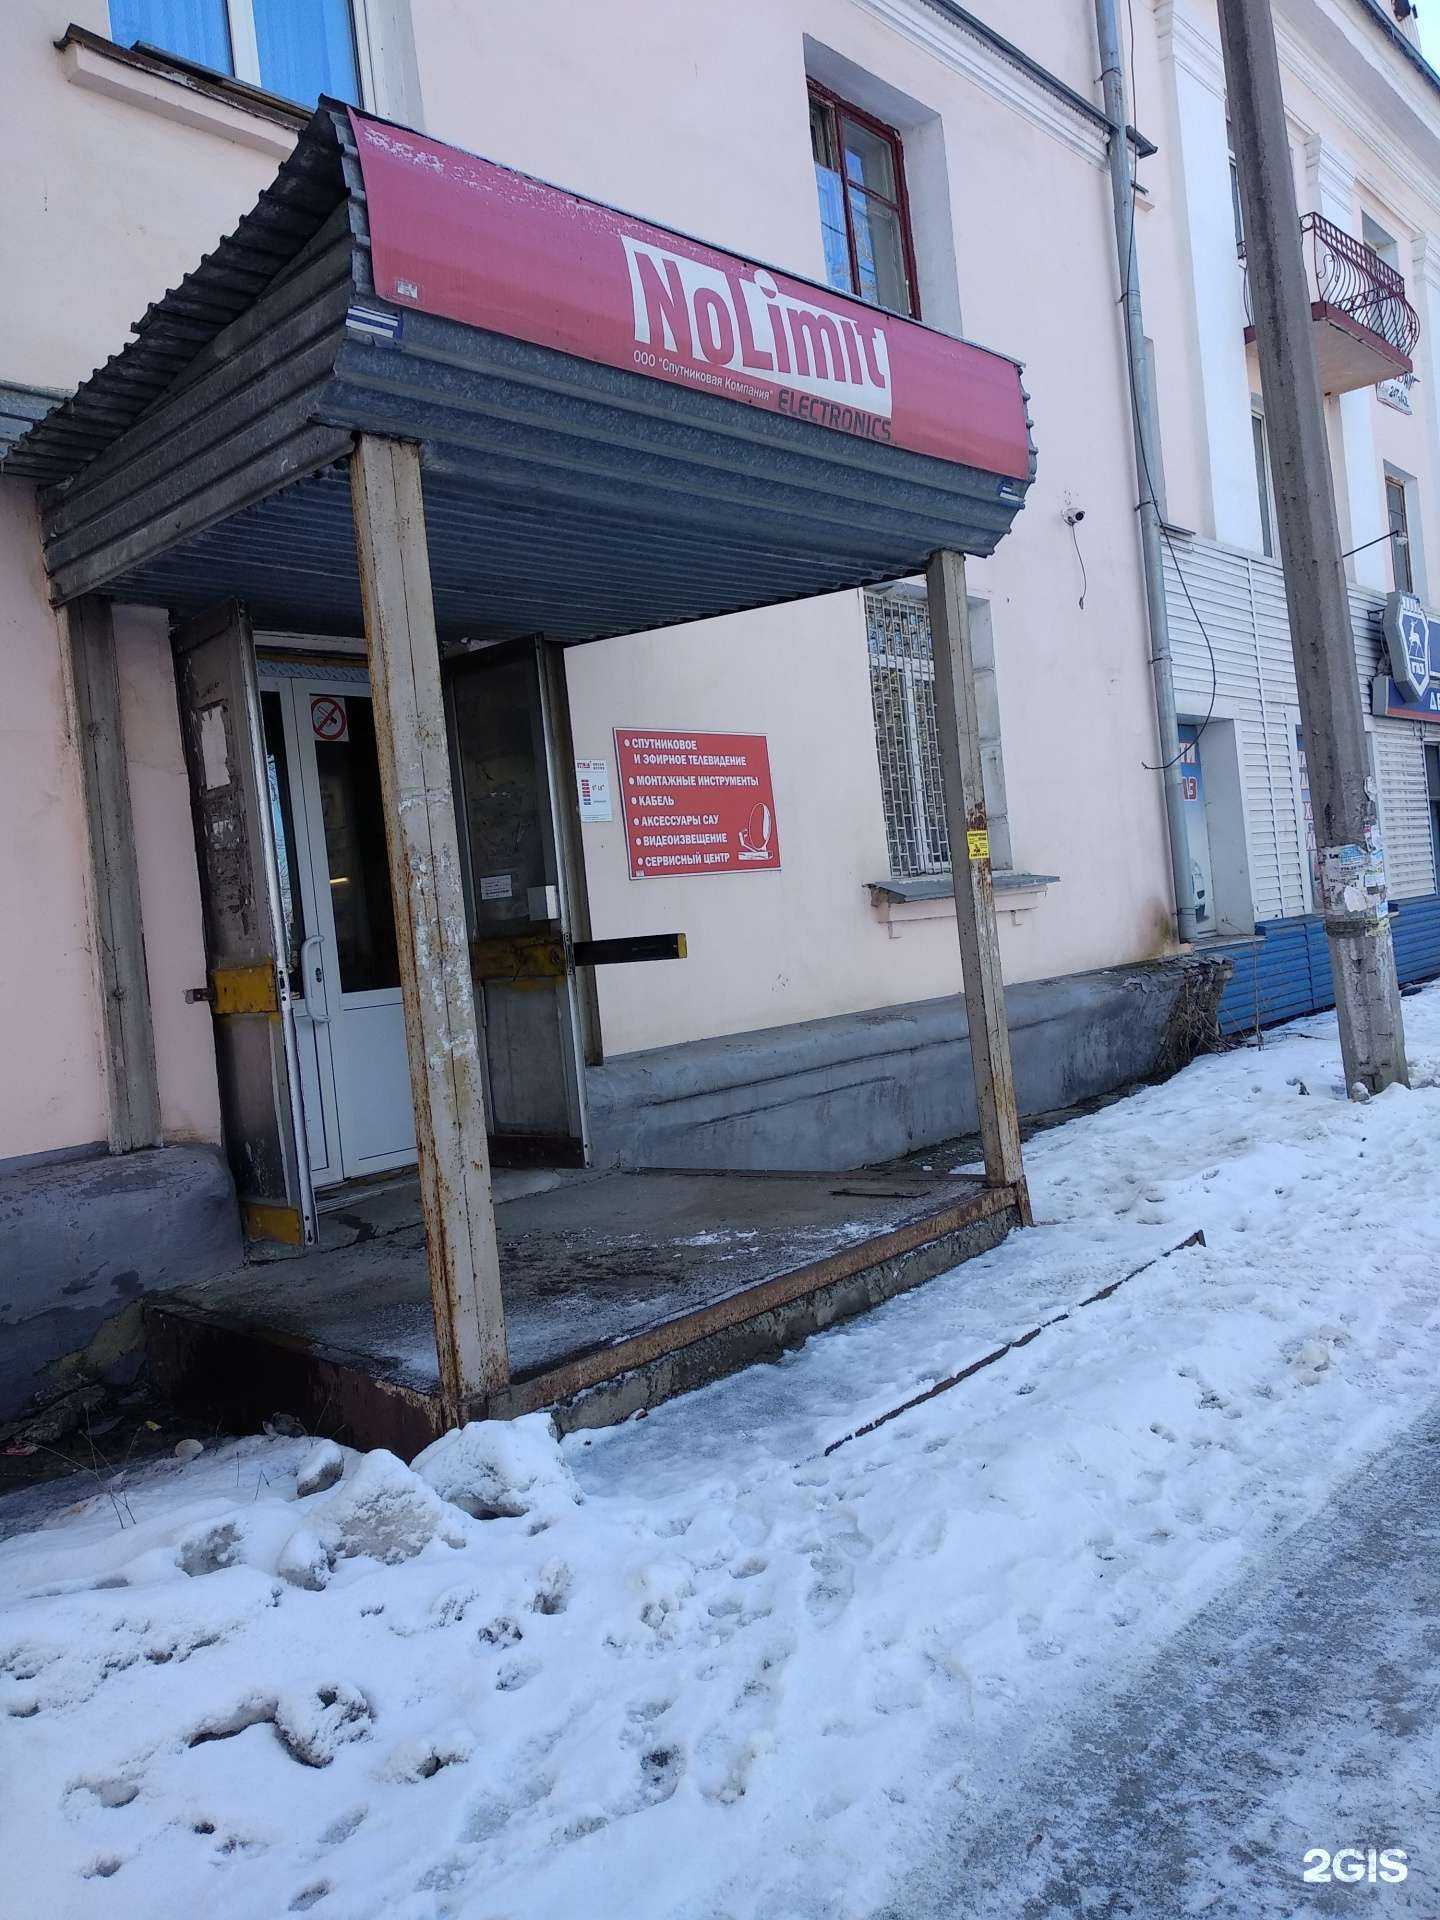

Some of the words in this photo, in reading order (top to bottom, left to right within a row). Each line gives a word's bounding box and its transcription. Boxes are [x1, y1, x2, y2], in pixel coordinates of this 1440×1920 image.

[631, 245, 887, 390] NoLimit
[633, 350, 656, 368] ООО
[658, 357, 723, 388] "Спутниковая
[724, 376, 773, 402] Компания"
[777, 388, 892, 441] ELECTRONICS
[631, 738, 697, 750] СПУТНИКОВОЕ
[633, 754, 642, 764] И
[643, 754, 687, 765] ЭФИРНОЕ
[688, 755, 747, 767] ТЕЛЕВИДЕНИЕ
[636, 775, 696, 786] МОНТАЖНЫЕ
[697, 775, 759, 786] ИНСТРУМЕНТЫ
[639, 795, 674, 806] КАБЕЛЬ
[641, 815, 701, 826] АКСЕССУАРЫ
[702, 814, 719, 825] САУ
[643, 832, 728, 847] ВИДЕОИЗВЕЩЕНИЕ
[645, 853, 702, 867] СЕРВИСНЫЙ
[703, 853, 730, 865] ЦЕНТР
